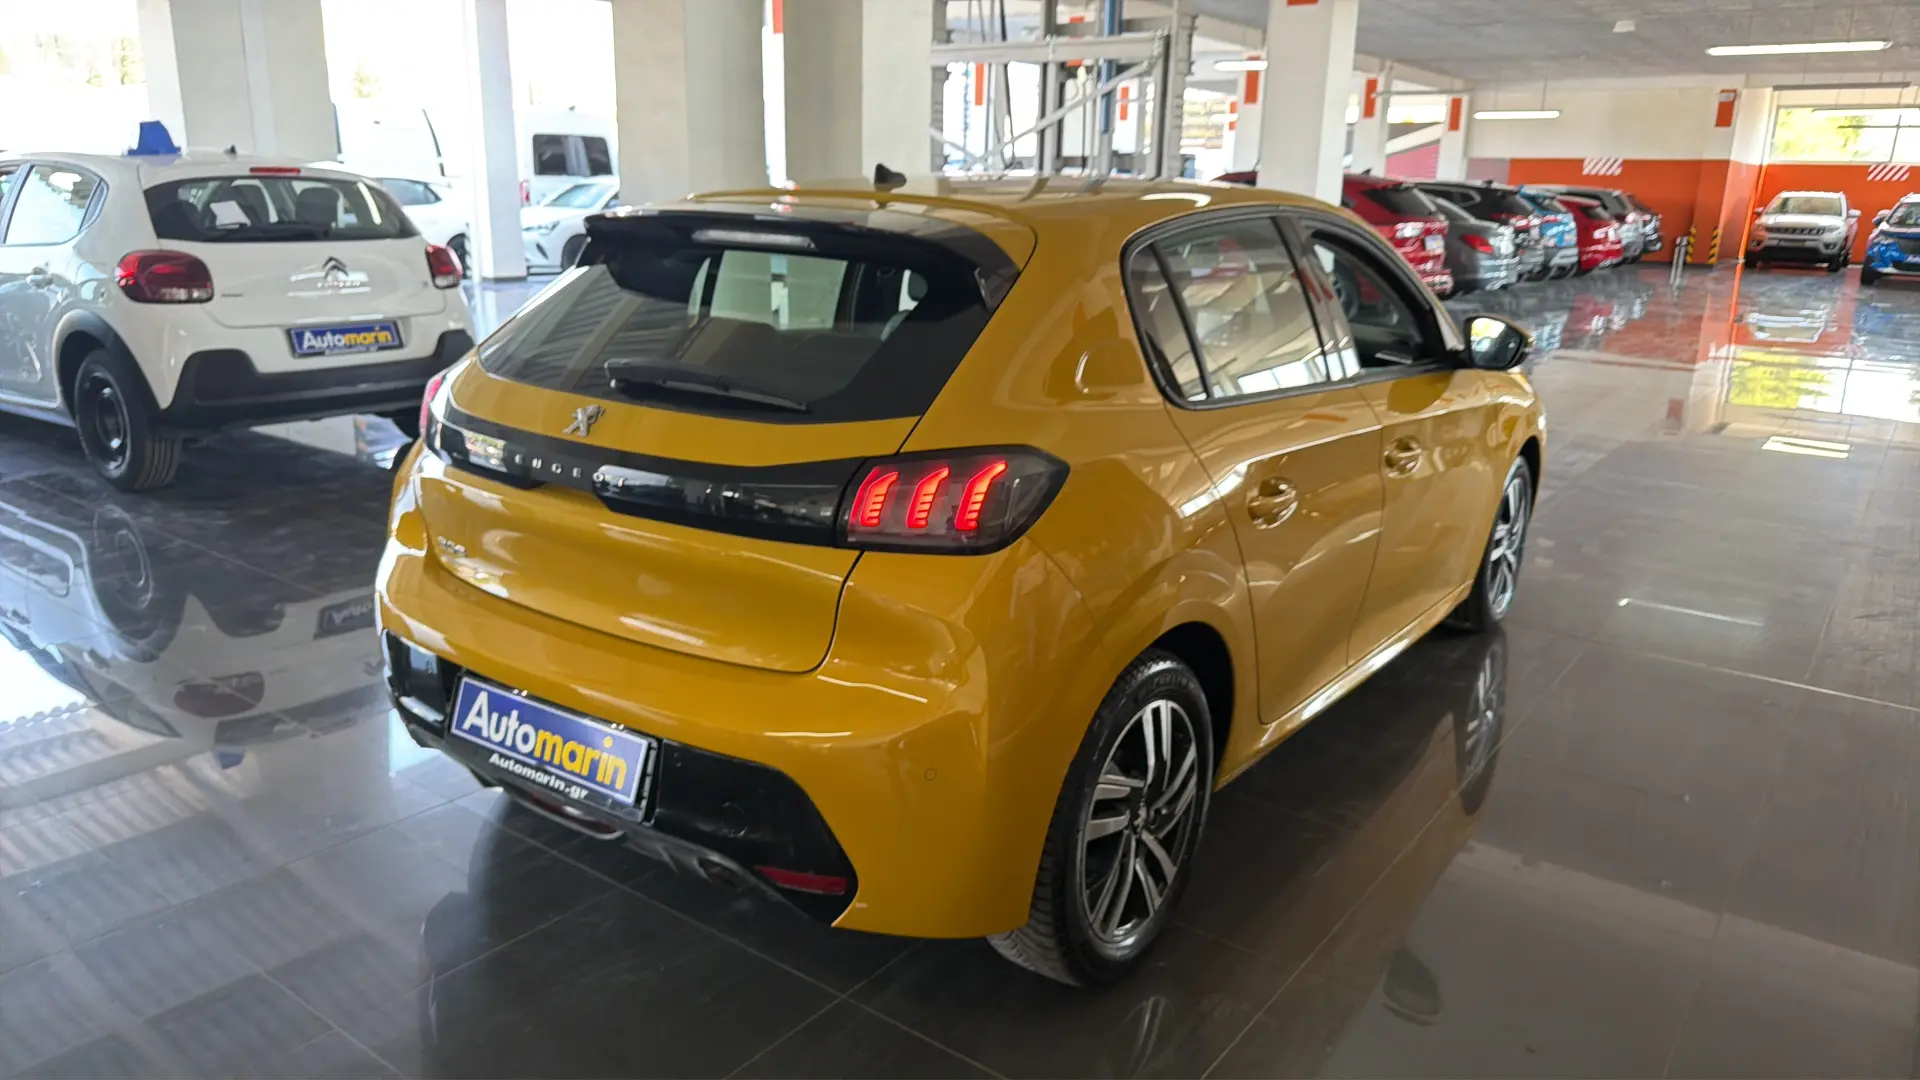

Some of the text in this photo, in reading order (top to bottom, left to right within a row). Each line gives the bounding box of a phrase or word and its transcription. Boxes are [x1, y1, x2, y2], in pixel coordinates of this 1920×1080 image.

[302, 324, 392, 350] Automarin
[494, 448, 627, 488] EUGEOT
[462, 690, 627, 790] Automarin
[488, 752, 589, 799] Automarin.gr
